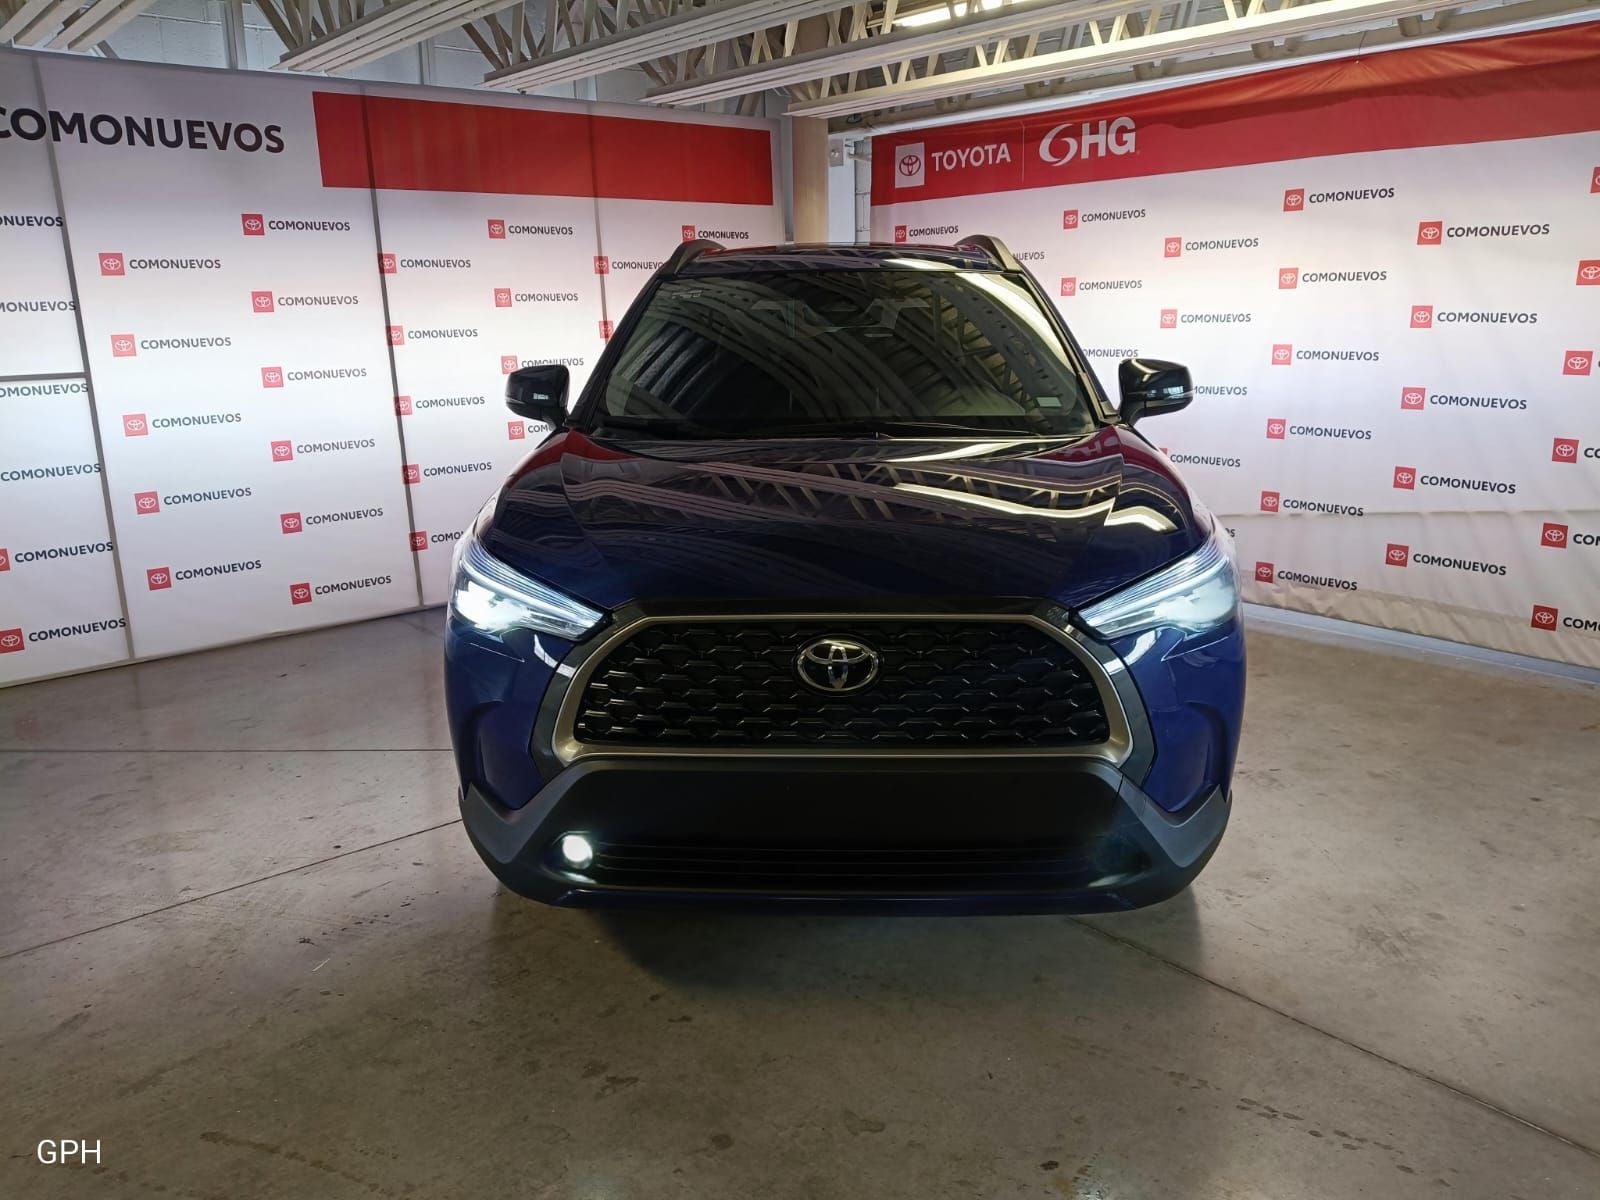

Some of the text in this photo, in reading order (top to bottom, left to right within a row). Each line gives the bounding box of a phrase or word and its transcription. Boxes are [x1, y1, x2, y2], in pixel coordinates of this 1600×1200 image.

[932, 142, 1011, 172] TOYOTA
[1309, 187, 1395, 203] COMONUEVOS
[0, 215, 63, 227] NUEVOS
[1080, 208, 1146, 223] COMONUEVOS
[267, 220, 351, 232] COMONUEVOS
[507, 225, 574, 236] COMONUEVOS
[908, 224, 960, 237] COMONUEVOS
[1447, 223, 1550, 237] COMONUEVOS
[697, 229, 749, 240] COMONUEVOS
[1184, 237, 1259, 250] COMONUEVOS
[128, 258, 222, 270] COMONUEVOS
[399, 258, 471, 269] COMONUEVOS
[1301, 270, 1387, 282] COMONUEVOS
[1077, 279, 1143, 291] COMONUEVOS
[276, 295, 359, 307] COMONUEVOS
[514, 292, 579, 303] COMONUEVOS
[1180, 313, 1252, 324] COMONUEVOS
[1436, 311, 1538, 323] COMONUEVOS
[407, 328, 479, 340] COMONUEVOS
[139, 336, 232, 349] COMONUEVOS
[1296, 350, 1380, 361] COMONUEVOS
[286, 367, 368, 382] COMONUEVOS
[414, 396, 486, 410] COMONUEVOS
[1430, 394, 1527, 409] COMONUEVOS
[151, 412, 242, 428] COMONUEVOS
[1288, 425, 1372, 439] COMONUEVOS
[296, 438, 376, 453] COMONUEVOS
[1169, 452, 1241, 468] COMONUEVOS
[1, 463, 101, 482] COMONUEVOS
[422, 461, 492, 478] COMONUEVOS
[1419, 475, 1516, 494] COMONUEVOS
[162, 487, 252, 505] COMONUEVOS
[1281, 497, 1365, 517] COMONUEVOS
[304, 507, 384, 526] COMONUEVOS
[14, 542, 114, 563] COMONUEVOS
[174, 559, 262, 580] COMONUEVOS
[1413, 553, 1507, 575] COMONUEVOS
[314, 575, 392, 596] COMONUEVOS
[1276, 570, 1358, 591] COMONUEVOS
[28, 618, 126, 643] COMONUEVOS
